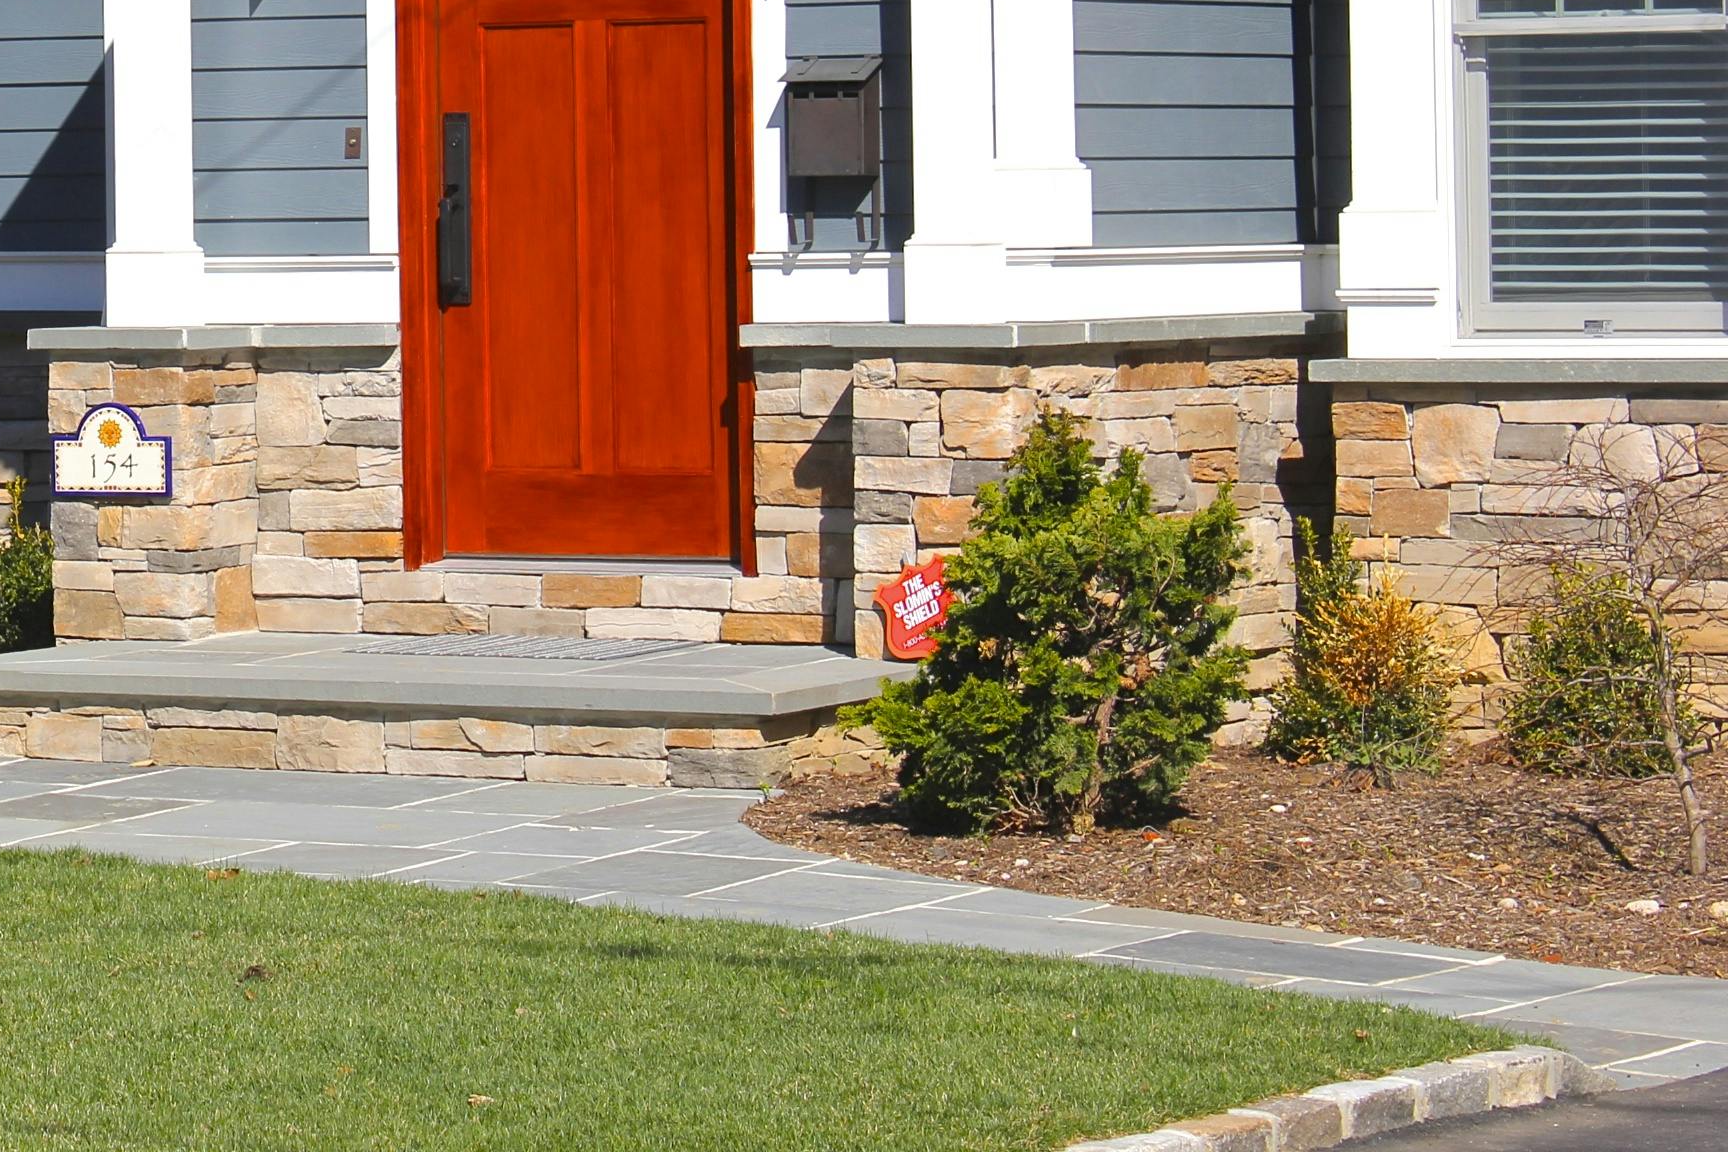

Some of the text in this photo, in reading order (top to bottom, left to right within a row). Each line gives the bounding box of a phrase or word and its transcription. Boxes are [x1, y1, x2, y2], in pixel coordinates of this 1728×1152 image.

[90, 453, 139, 484] 154
[893, 580, 944, 619] SLOMIN'S
[902, 573, 925, 596] THE
[902, 599, 940, 631] SHIELD
